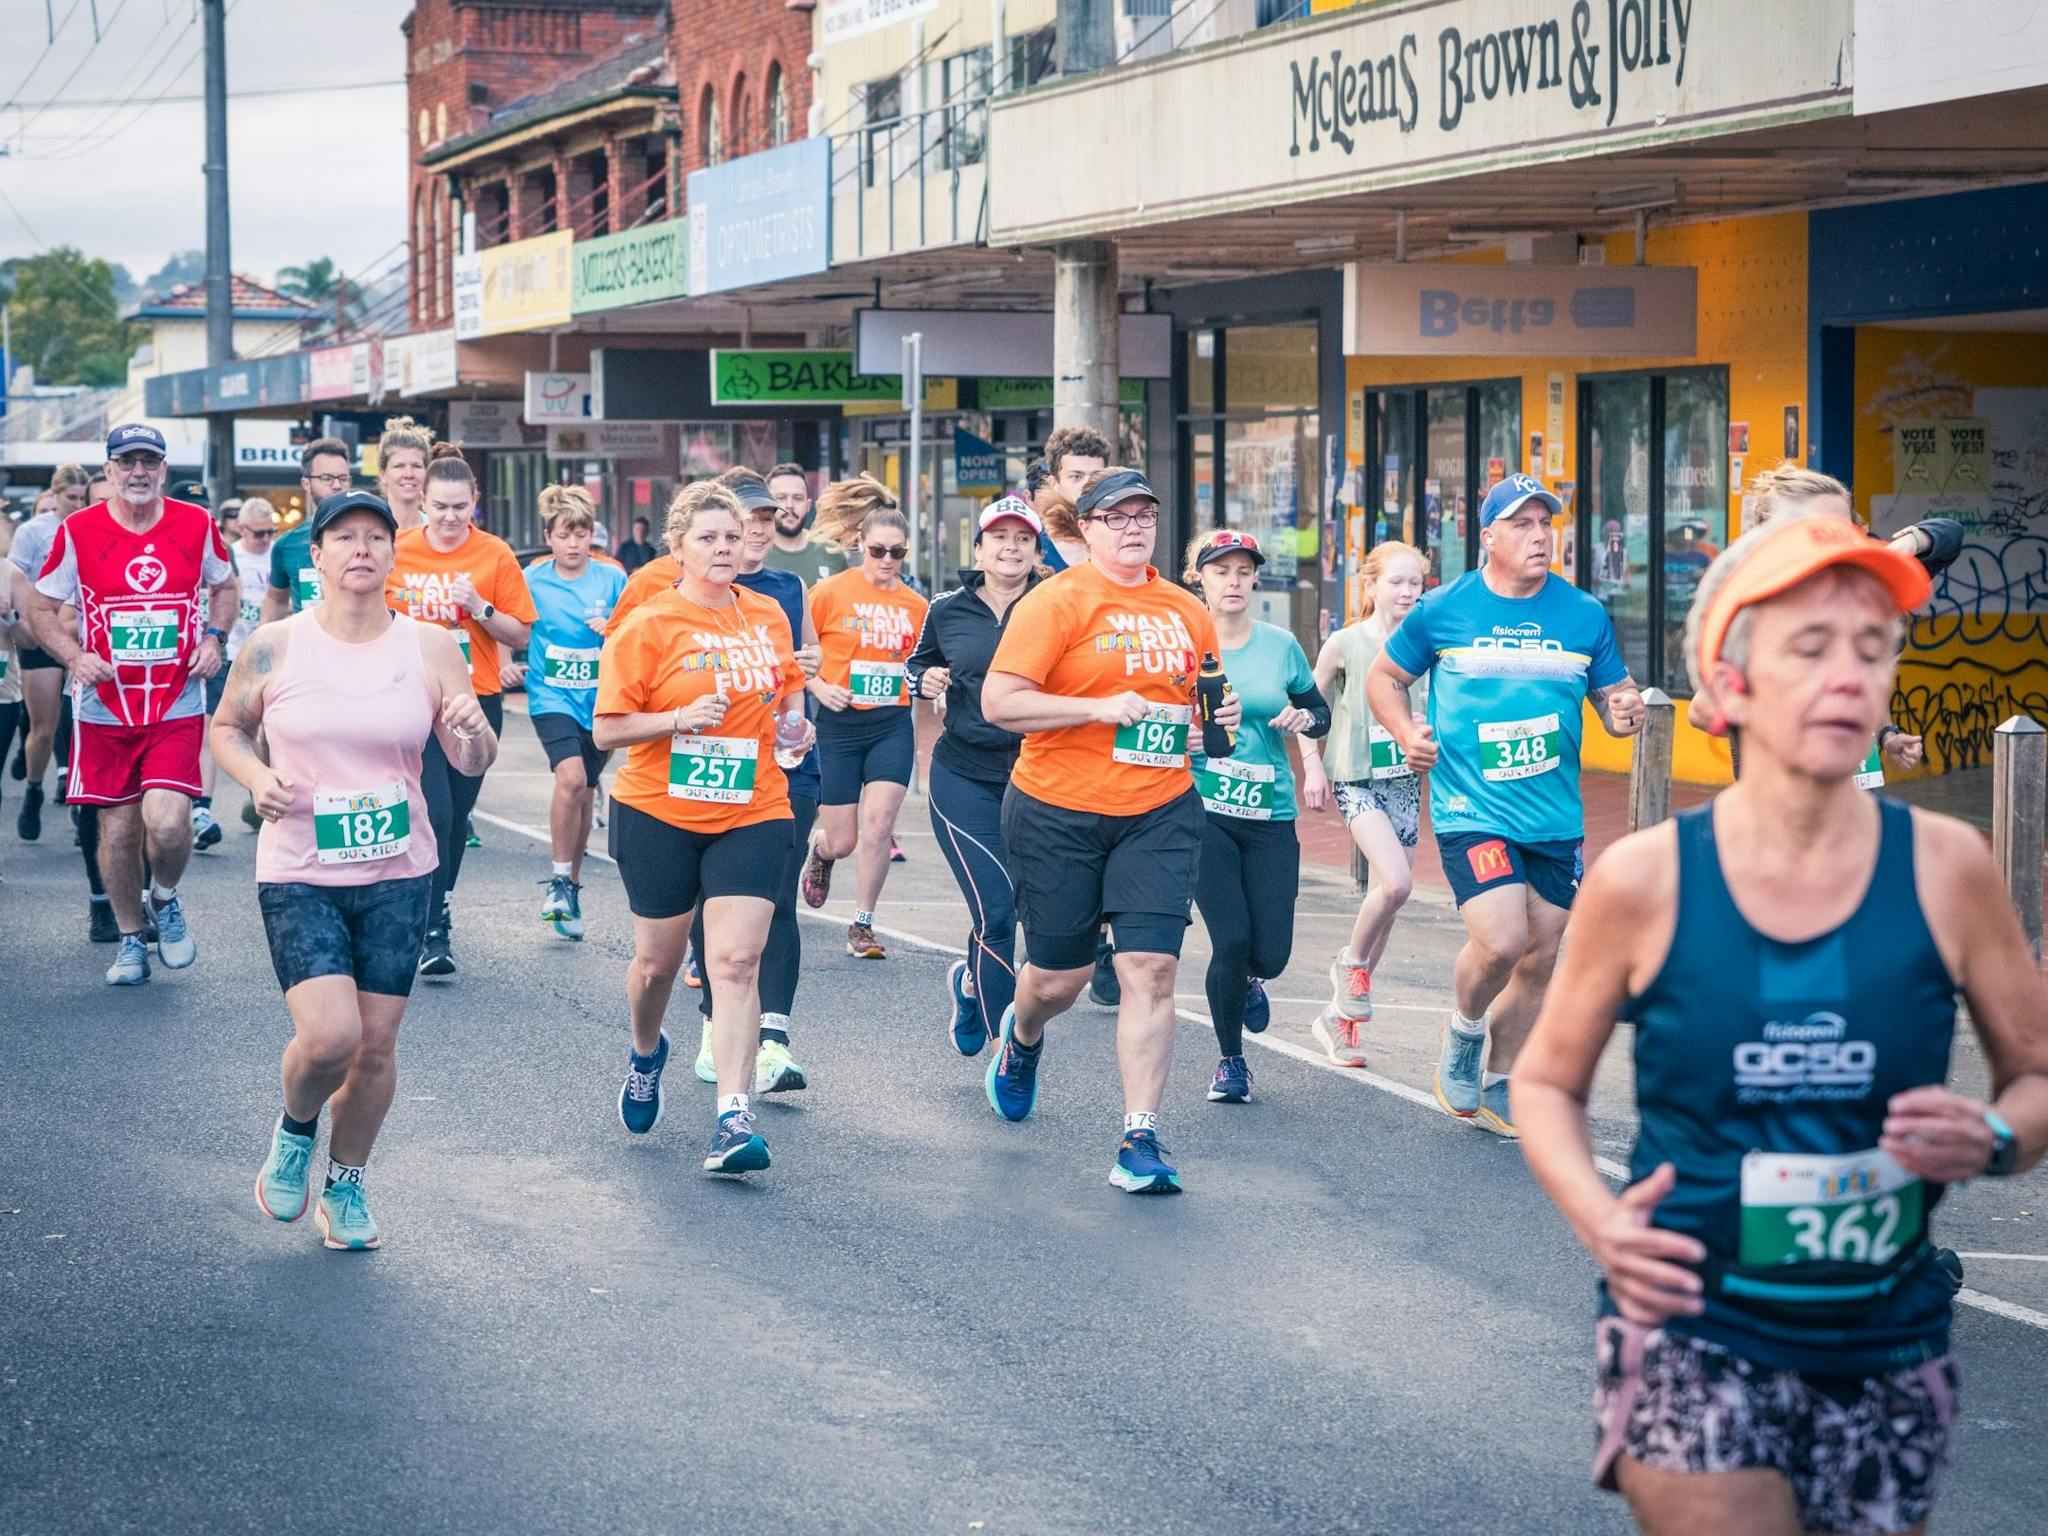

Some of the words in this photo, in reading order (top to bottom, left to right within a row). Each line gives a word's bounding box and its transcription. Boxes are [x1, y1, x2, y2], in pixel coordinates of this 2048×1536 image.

[1438, 19, 1562, 131] Brown
[1569, 0, 1601, 109] &
[1902, 428, 1936, 440] VOTE
[1951, 428, 1985, 440] VOTE
[1903, 440, 1936, 454] YES!
[1951, 440, 1985, 454] YES!
[960, 454, 996, 468] NOW
[959, 469, 998, 482] OPEN
[1513, 475, 1537, 494] KC
[423, 587, 454, 605] RU
[853, 602, 911, 619] WALK
[872, 617, 915, 634] RUN
[1105, 611, 1183, 632] WALK
[1492, 625, 1542, 637] fisiocrem
[126, 627, 165, 649] 277
[691, 624, 776, 649] WALK
[1139, 629, 1194, 651] RUN
[726, 644, 781, 670] RUN
[556, 661, 592, 680] 248
[863, 676, 893, 695] 188
[1136, 722, 1177, 753] 196
[1495, 737, 1547, 767] 348
[687, 757, 742, 789] 257
[1213, 776, 1263, 808] 346
[1447, 811, 1478, 819] COAST
[338, 810, 395, 847] 182
[1786, 1195, 1902, 1266] 362
